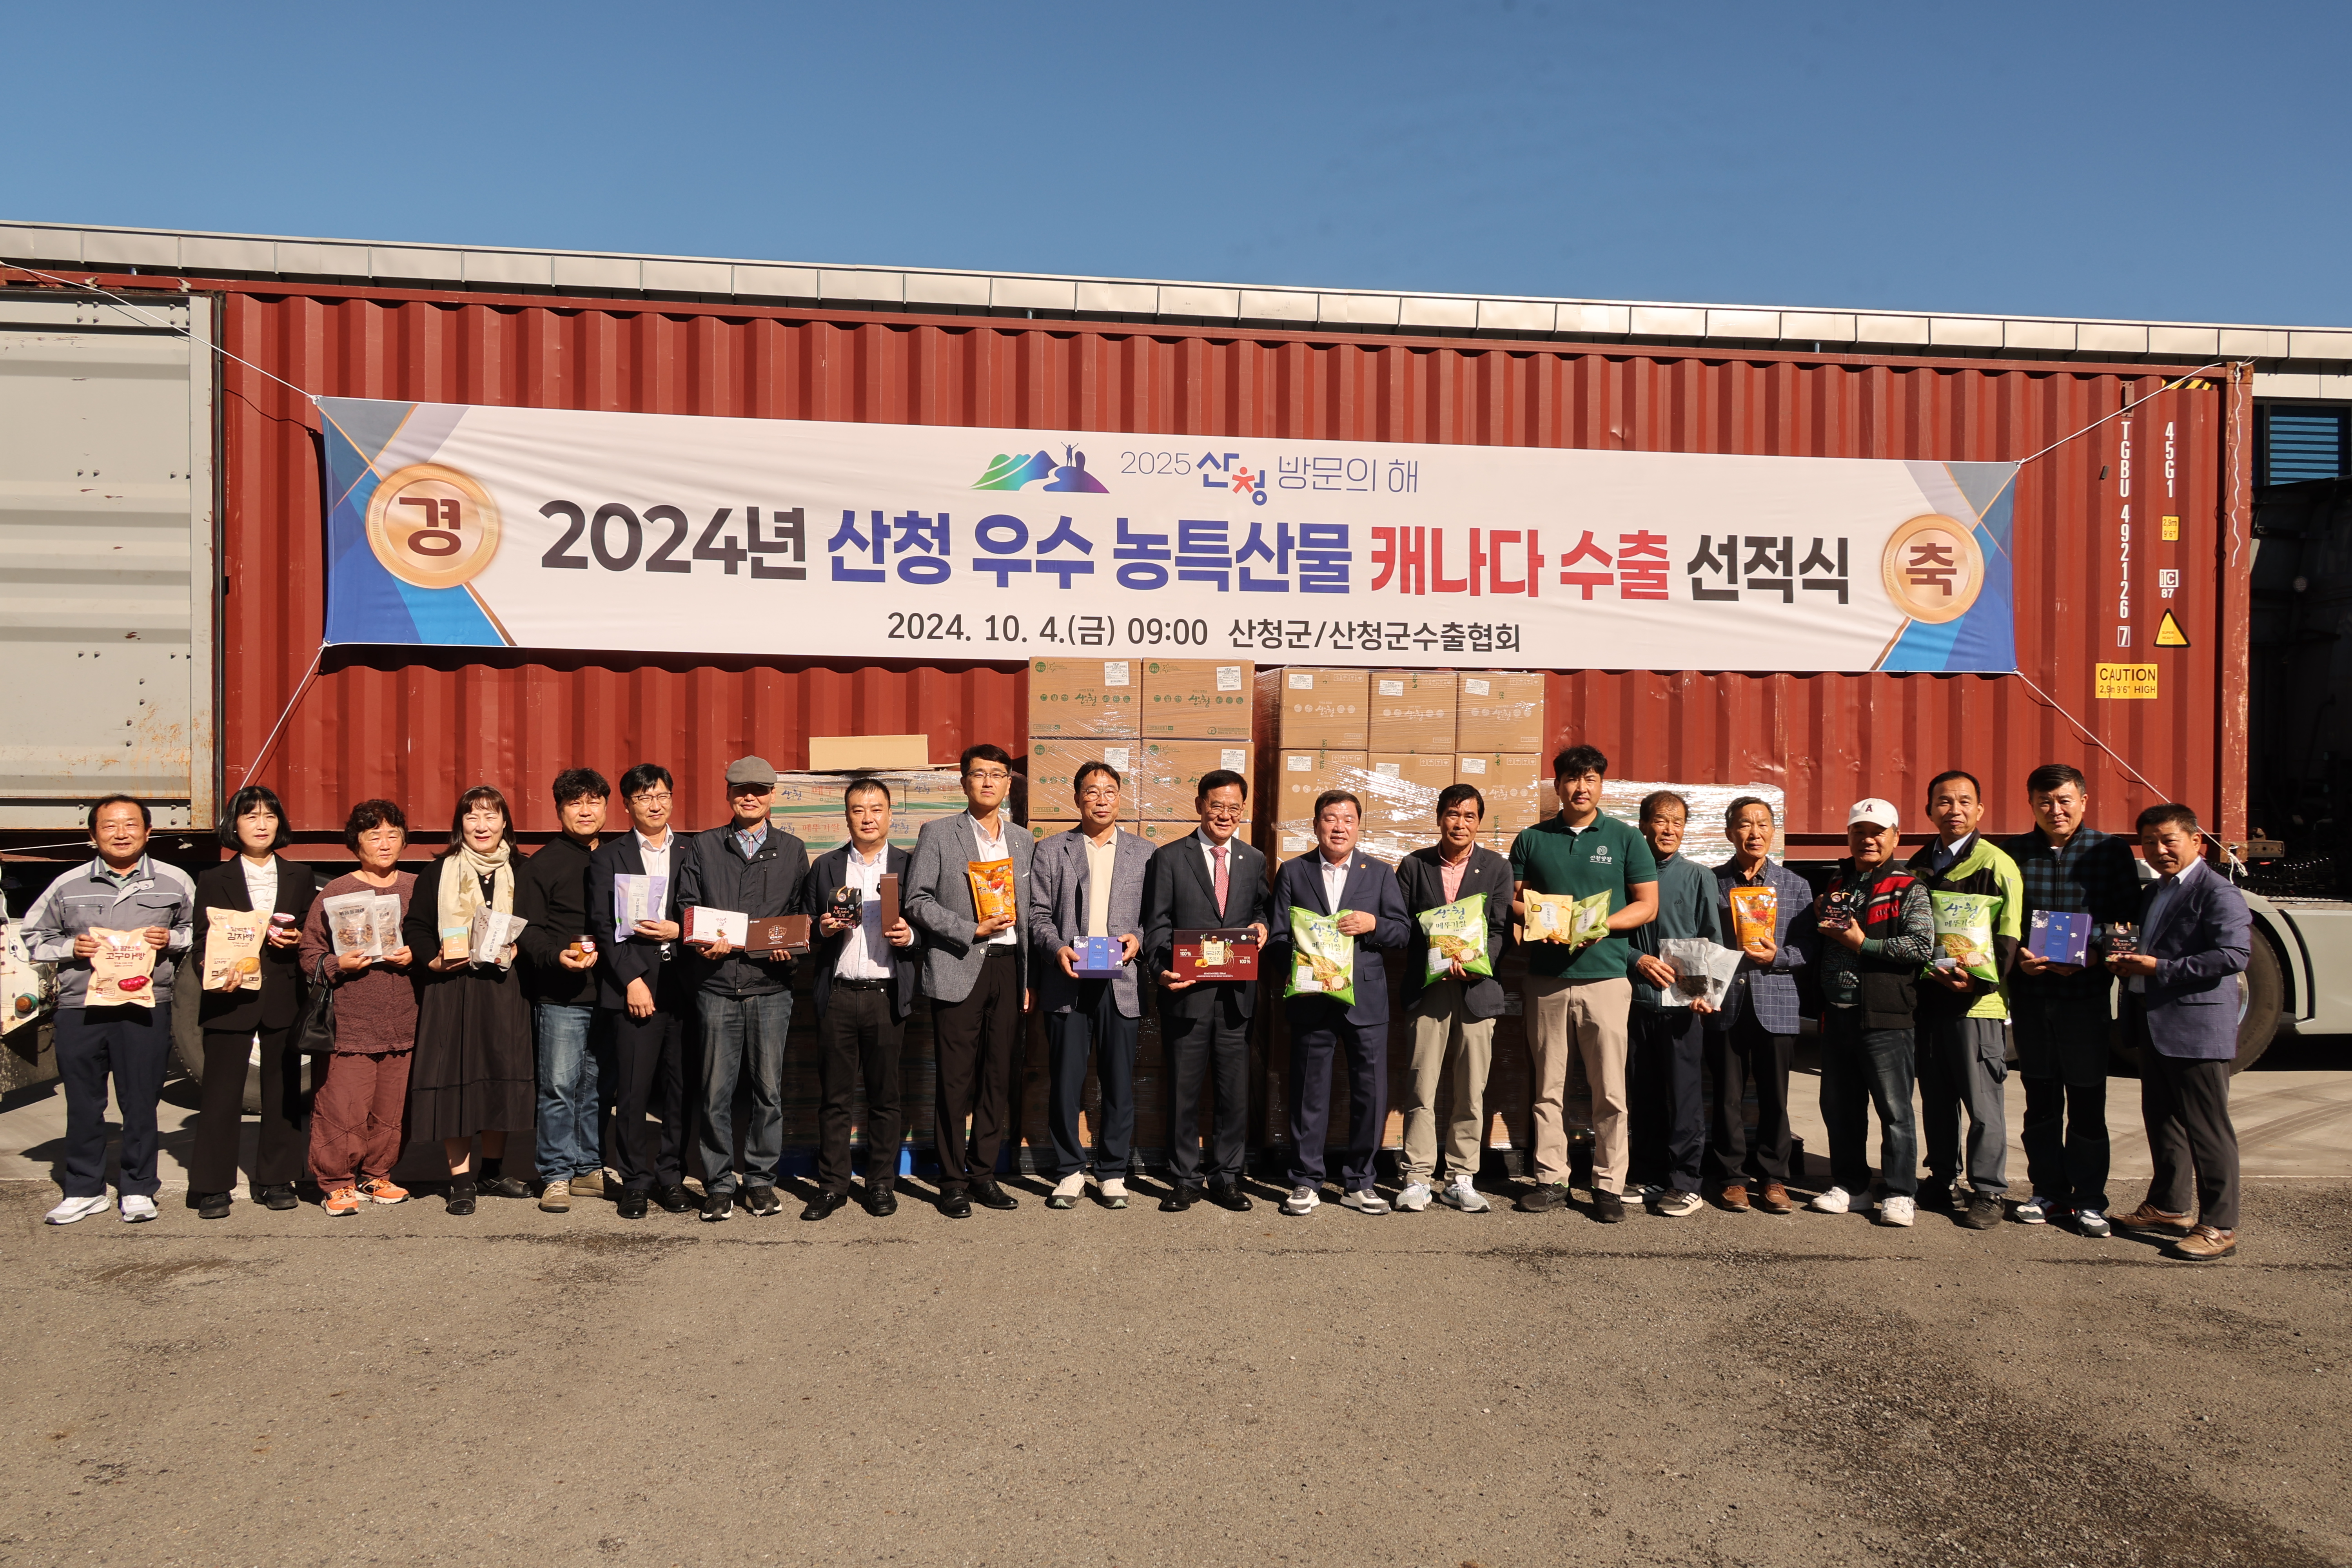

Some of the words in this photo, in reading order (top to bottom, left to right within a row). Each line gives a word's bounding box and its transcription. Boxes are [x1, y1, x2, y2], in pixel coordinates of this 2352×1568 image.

[2120, 421, 2131, 497] TGBU
[2165, 422, 2174, 498] 45G1
[1121, 452, 1191, 475] 2025
[1197, 452, 1267, 505] 산청
[1279, 456, 1376, 491] 방문의
[1389, 459, 1417, 492] 해
[399, 497, 461, 556] 경
[539, 500, 806, 580] 2024년
[828, 510, 951, 584] 산청
[973, 514, 1094, 589] 우수
[1114, 518, 1352, 593] 농특산물
[1372, 526, 1544, 597] 캐나다
[1561, 530, 1670, 600] 수출
[1688, 535, 1848, 604] 선적식
[2120, 505, 2130, 618] 492126
[1905, 543, 1957, 596] 축
[2161, 589, 2174, 598] 87
[888, 612, 971, 641] 2024.
[985, 615, 1027, 642] 10.
[1040, 615, 1114, 646] 4.(금)
[1128, 618, 1207, 645] 09:00
[1228, 619, 1519, 652] 산청군/산청군수출협회
[2119, 627, 2129, 646] 7
[2100, 668, 2156, 681] CAUTION
[802, 823, 840, 832] 메뚜기쌀
[227, 933, 255, 941] 감자빵
[1436, 920, 1466, 929] 메뚜기쌀
[1945, 919, 1975, 927] 메뚜기쌀
[1312, 942, 1341, 952] 메뚜기쌀
